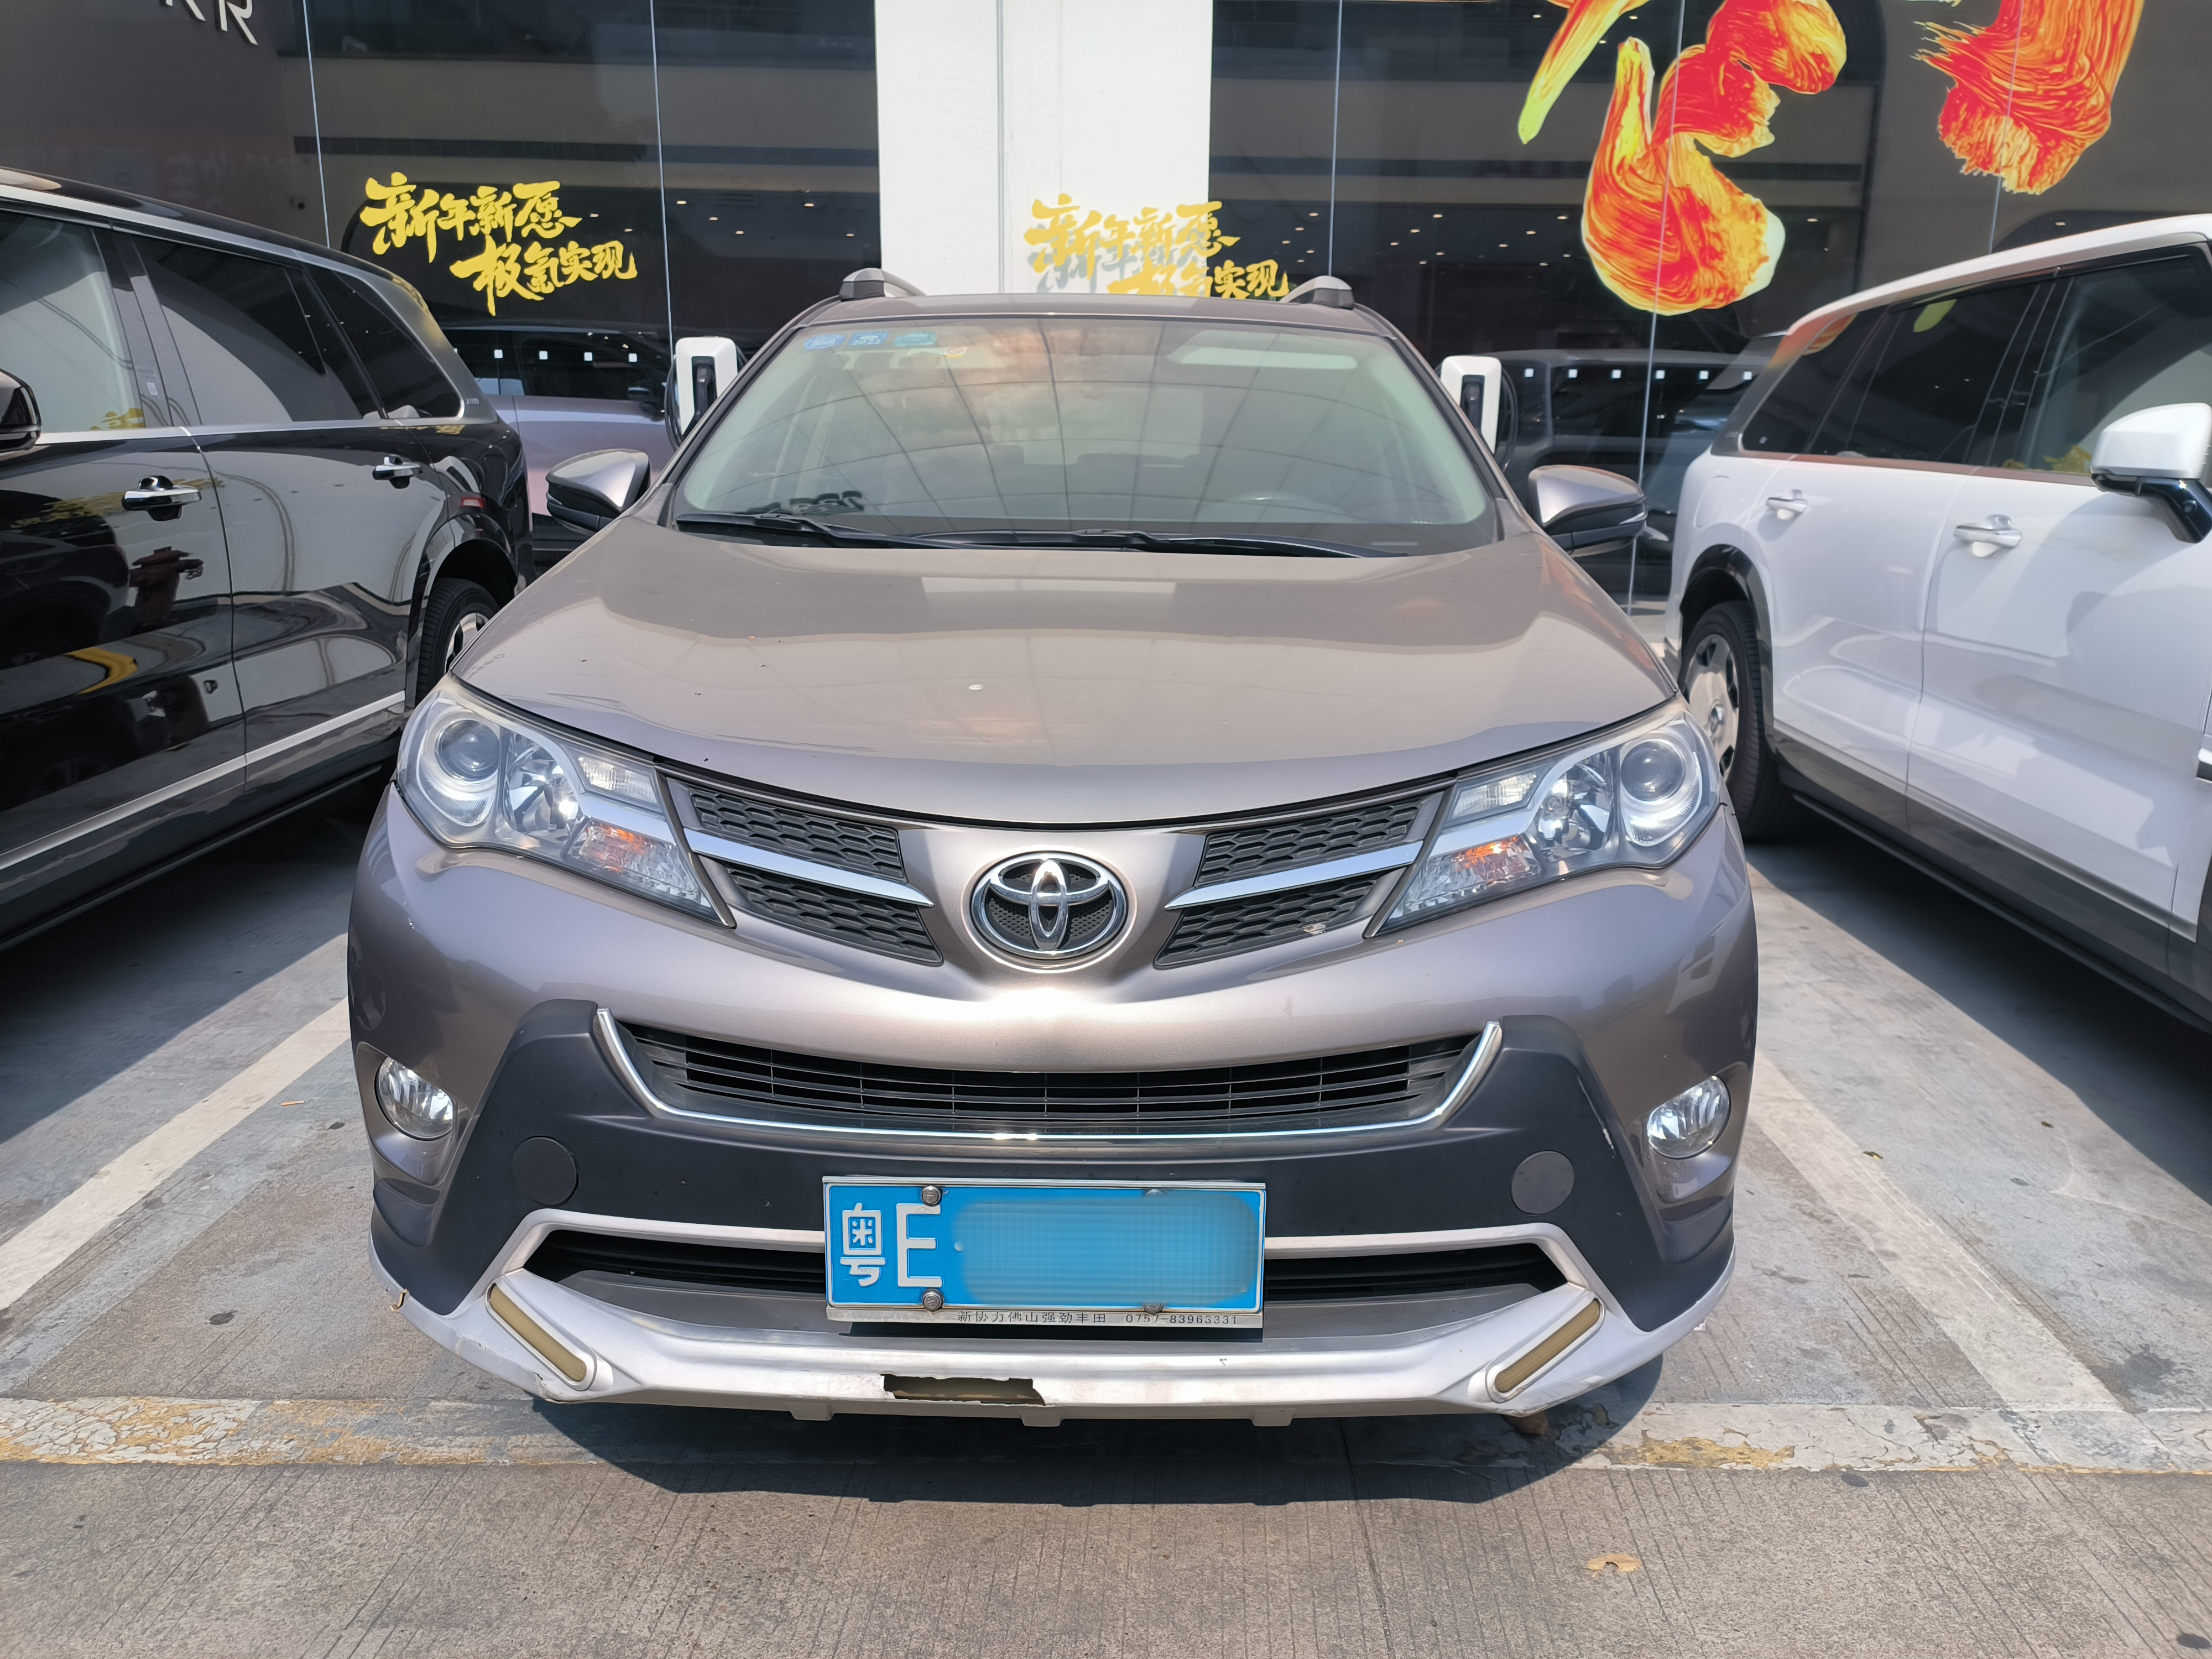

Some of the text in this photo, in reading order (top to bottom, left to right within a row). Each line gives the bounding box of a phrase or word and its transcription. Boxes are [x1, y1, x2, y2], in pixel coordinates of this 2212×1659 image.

[359, 171, 582, 263] 新年新愿
[1024, 194, 1240, 281] 新年新愿
[449, 234, 638, 316] 极氪实现
[957, 1311, 1237, 1324] 新协力佛山强劲丰田 0757-83963331
